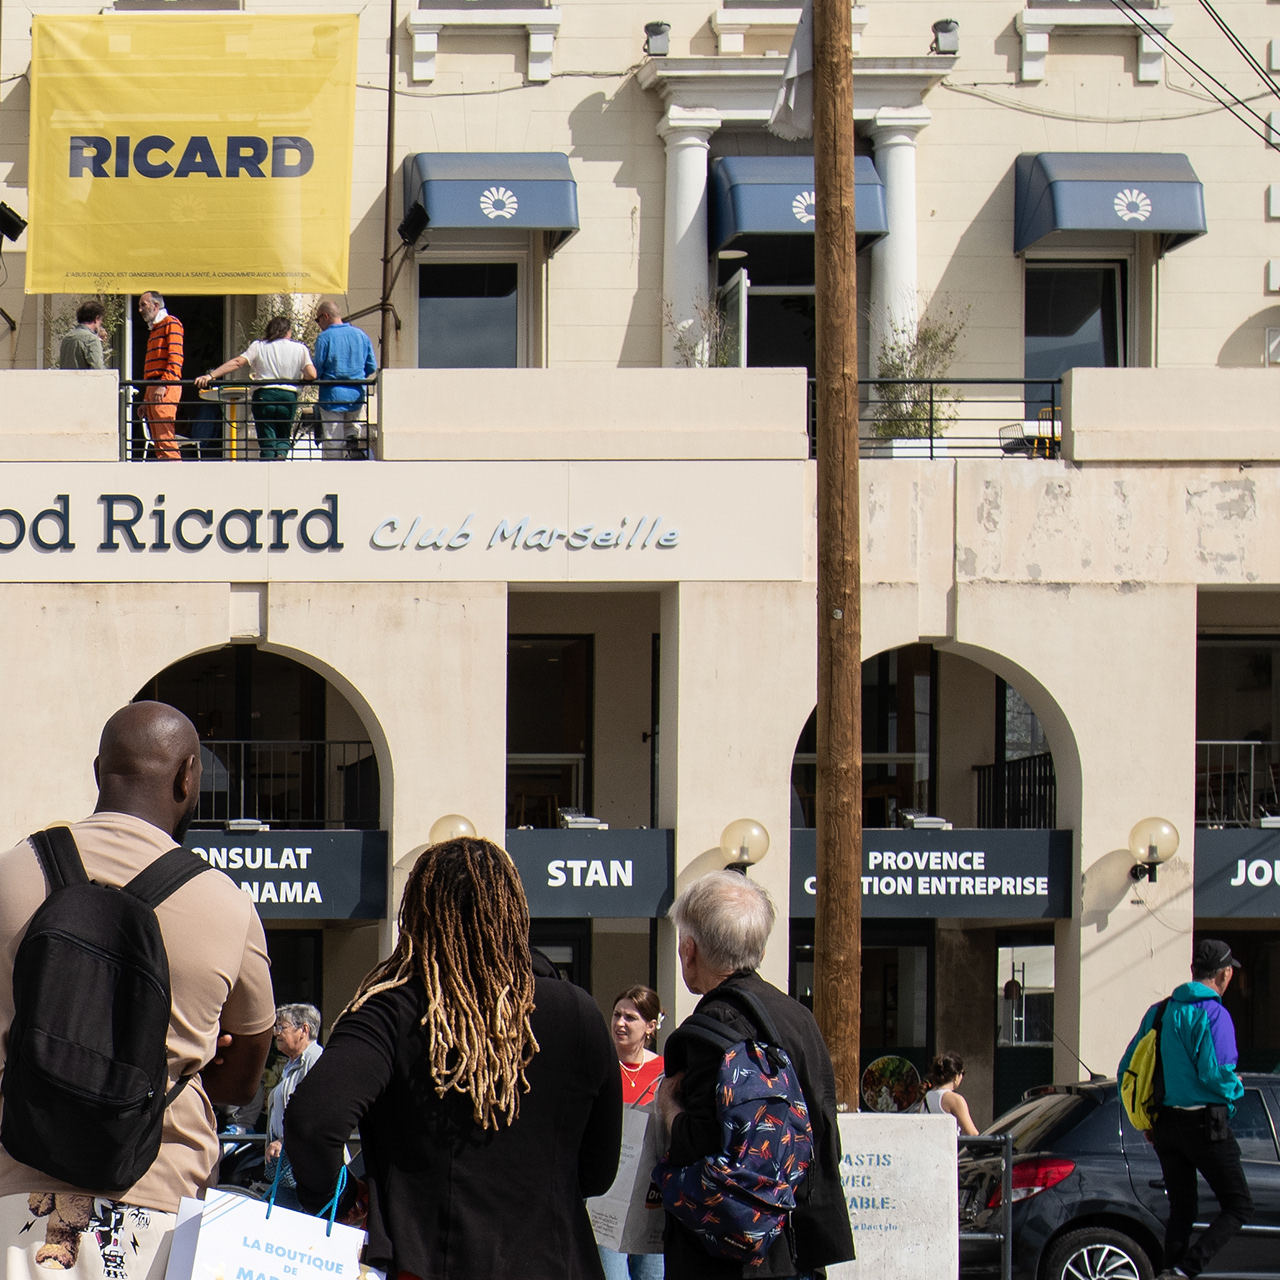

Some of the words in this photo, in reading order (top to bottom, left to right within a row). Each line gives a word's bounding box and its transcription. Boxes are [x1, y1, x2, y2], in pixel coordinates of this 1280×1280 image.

[69, 135, 314, 178] RICARD
[98, 494, 344, 552] Ricard
[371, 512, 475, 550] Club
[488, 515, 680, 550] Marseille
[869, 851, 985, 870] PROVENCE
[547, 860, 632, 887] STAN
[1230, 859, 1280, 887] JO
[241, 881, 323, 903] NAMA
[804, 876, 912, 895] CTION
[918, 876, 1049, 895] ENTREPRISE
[841, 1153, 891, 1166] ASTIS
[841, 1175, 871, 1187] VEC
[846, 1196, 896, 1209] ABLE.
[861, 1223, 898, 1232] Dactylo
[242, 1236, 261, 1251] LA
[264, 1242, 344, 1275] BOUTIQUE
[283, 1265, 298, 1276] DE
